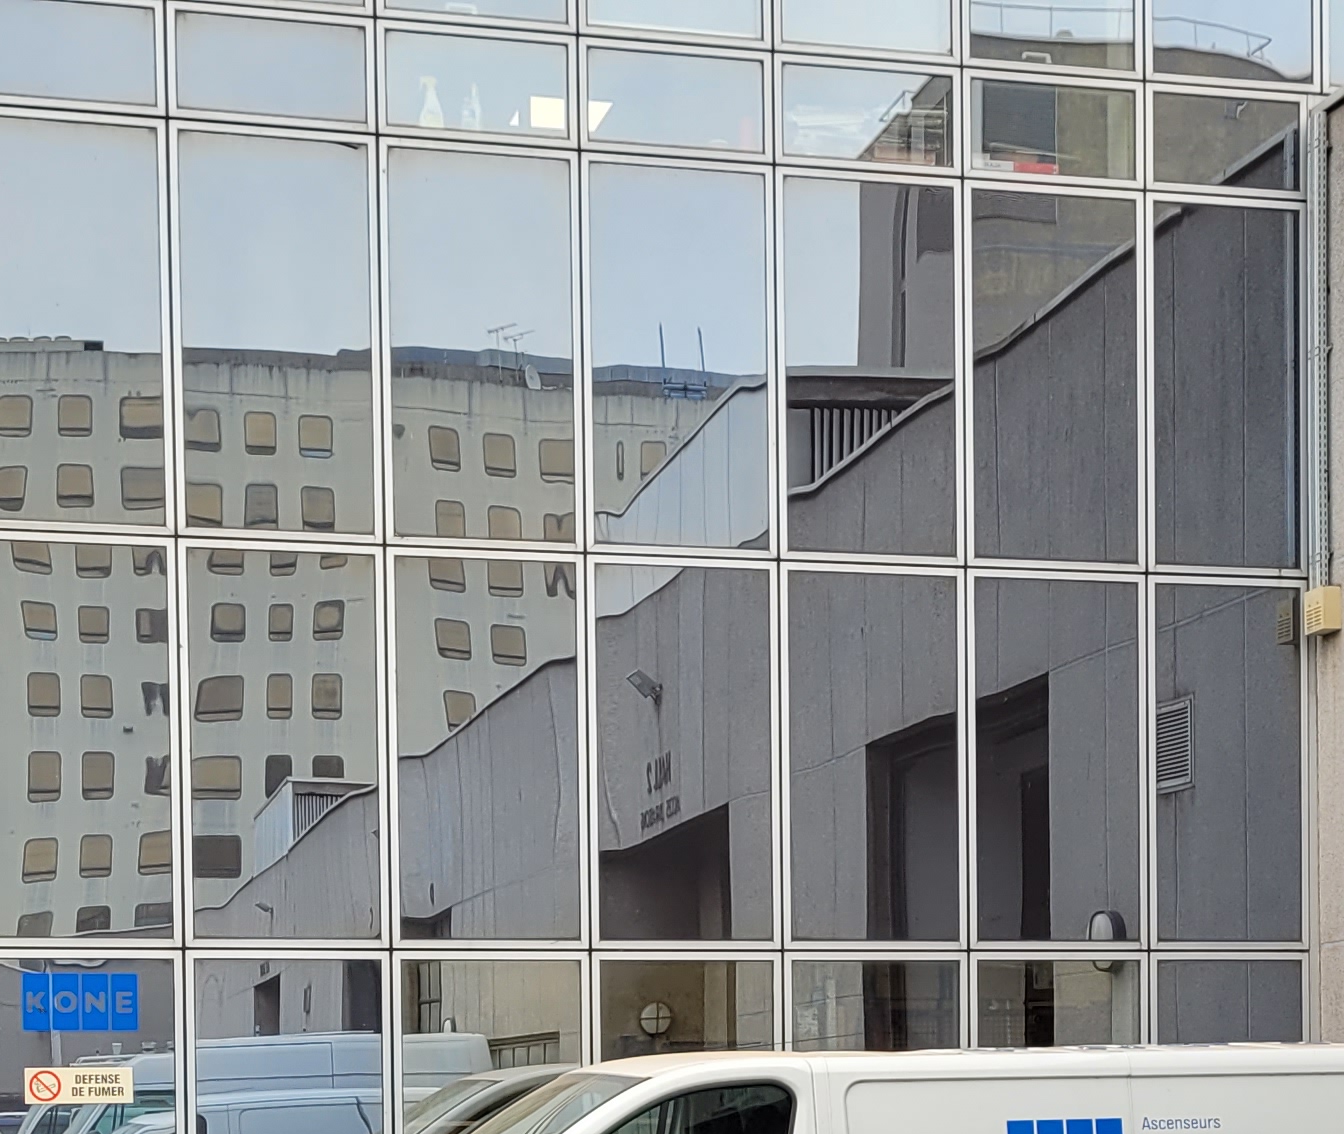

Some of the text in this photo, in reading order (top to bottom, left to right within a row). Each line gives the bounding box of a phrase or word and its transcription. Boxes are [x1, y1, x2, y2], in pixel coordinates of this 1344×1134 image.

[25, 990, 133, 1013] KONE
[74, 1074, 121, 1085] DEFENSE
[71, 1086, 125, 1097] DE FUMER
[1141, 1116, 1222, 1130] Ascenseurs
